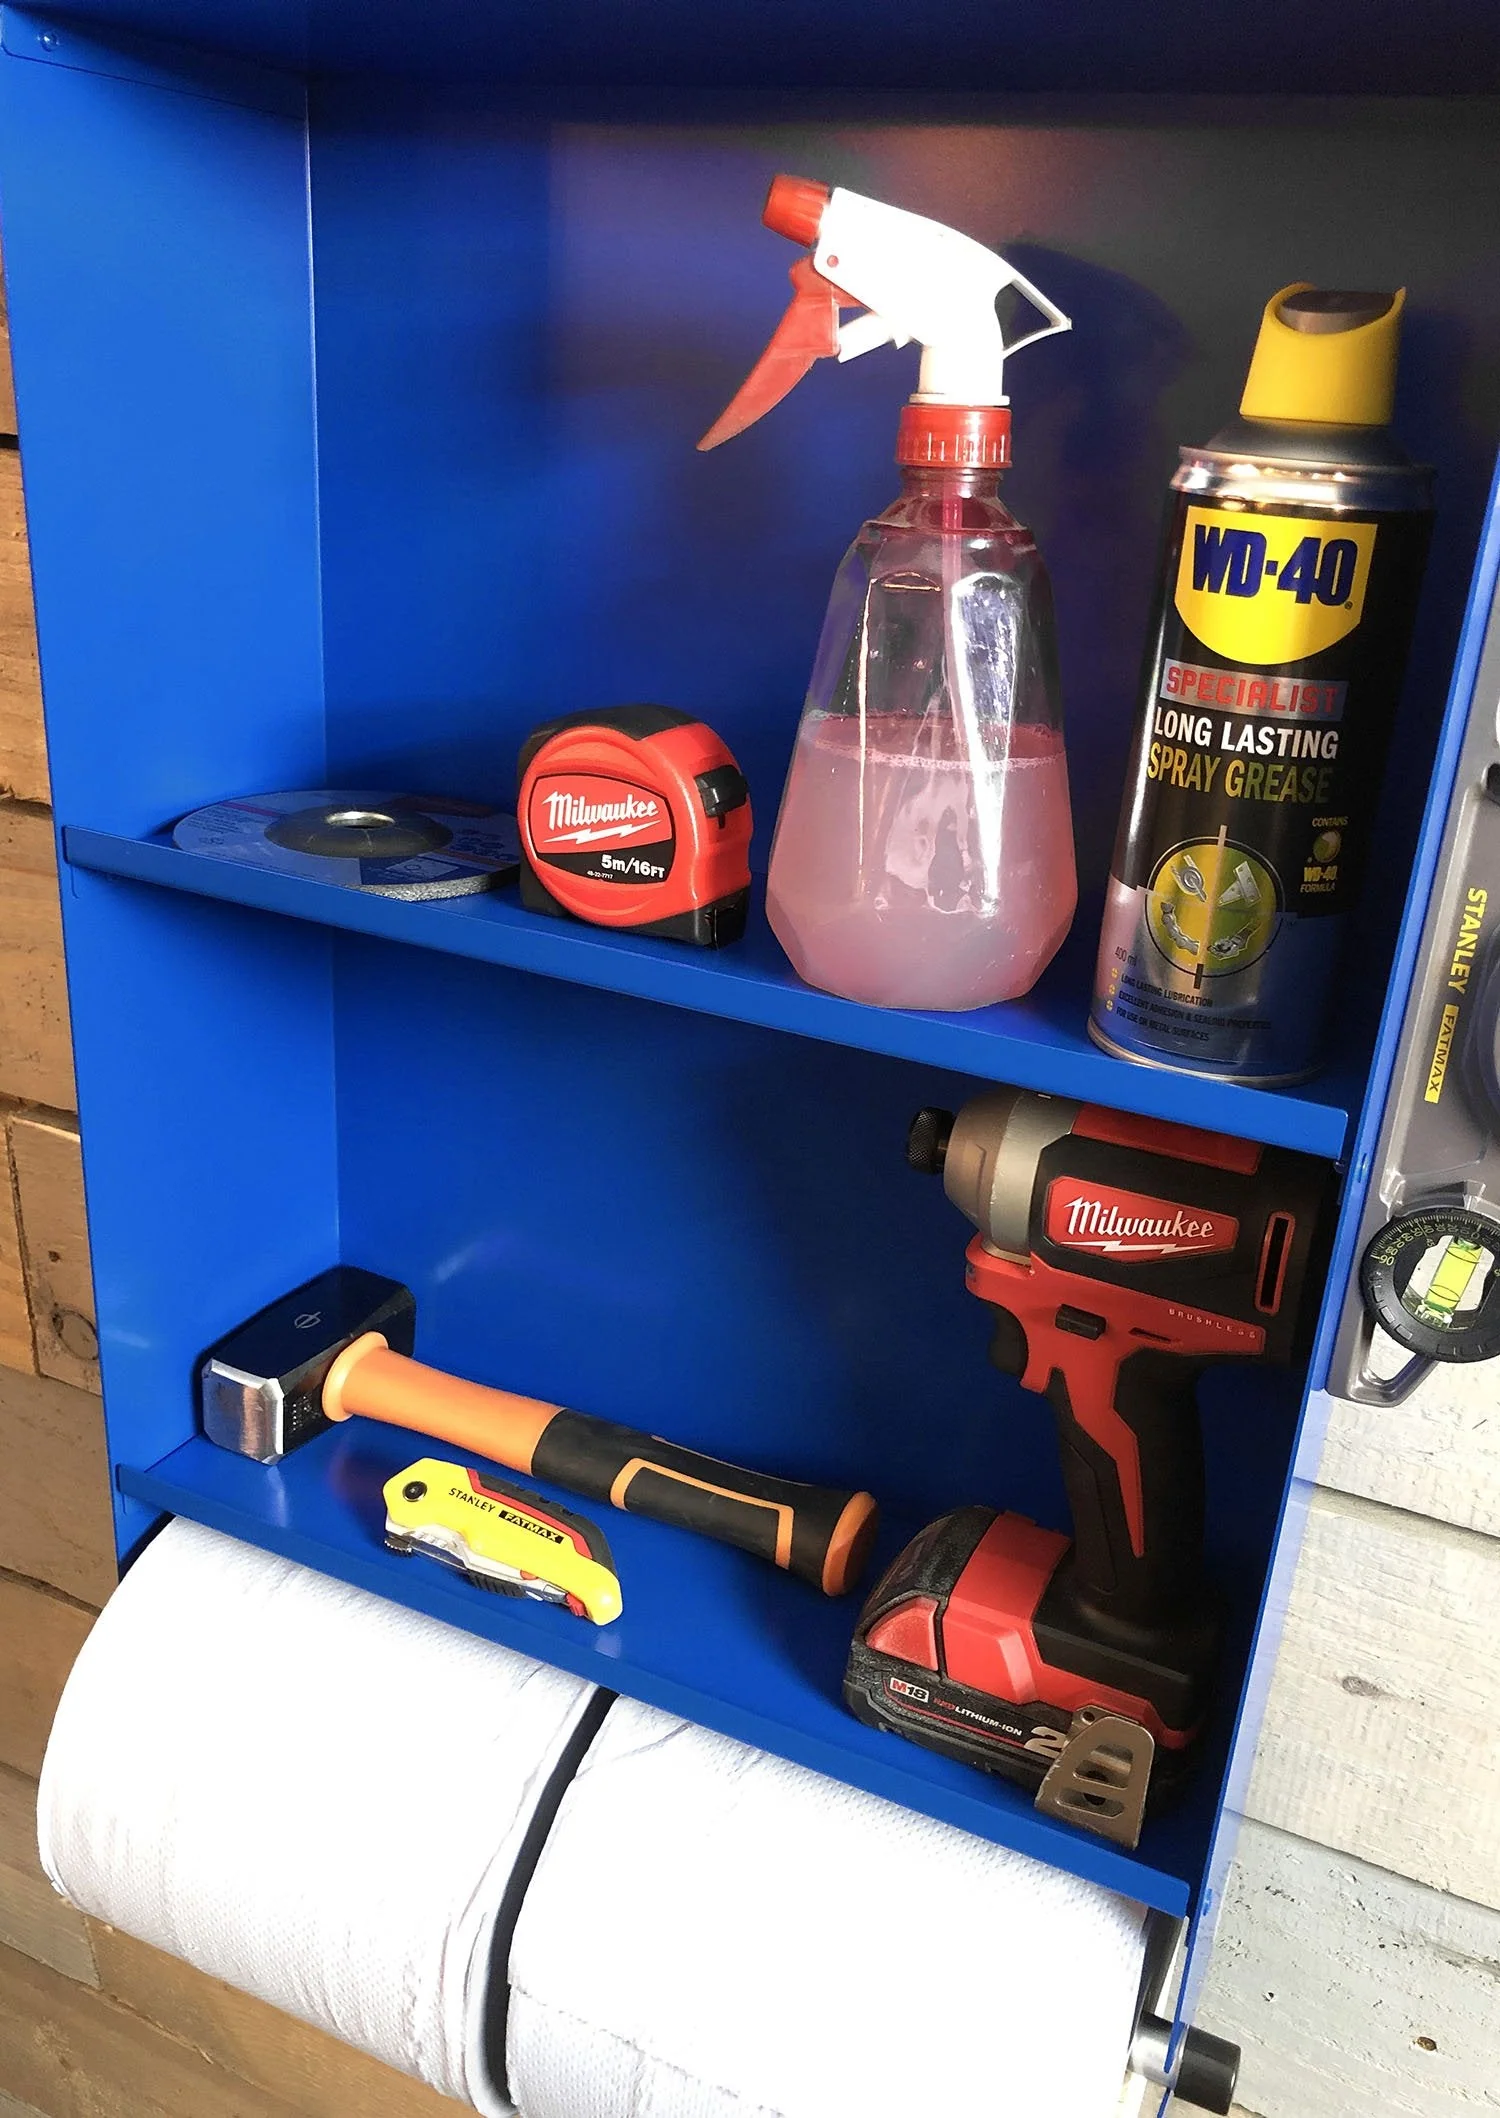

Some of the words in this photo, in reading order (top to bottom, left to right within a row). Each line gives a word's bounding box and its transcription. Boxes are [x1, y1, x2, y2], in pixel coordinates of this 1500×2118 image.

[1192, 523, 1358, 606] WD-40
[1166, 665, 1339, 713] SPECIALIST
[1154, 706, 1212, 747] LONG
[1220, 721, 1339, 759] LASTING
[1147, 742, 1222, 793] SPRAY
[1224, 759, 1333, 803] GREASE
[541, 791, 659, 831] Milwaukee
[601, 853, 665, 878] 5m/16FT
[1447, 887, 1488, 995] STANLEY
[1429, 1014, 1455, 1092] FATMAX
[1064, 1196, 1216, 1239] Milwaukee
[1379, 1254, 1395, 1266] 90
[448, 1487, 496, 1513] STANLEY
[504, 1512, 560, 1543] FATMAX
[891, 1679, 928, 1701] M18
